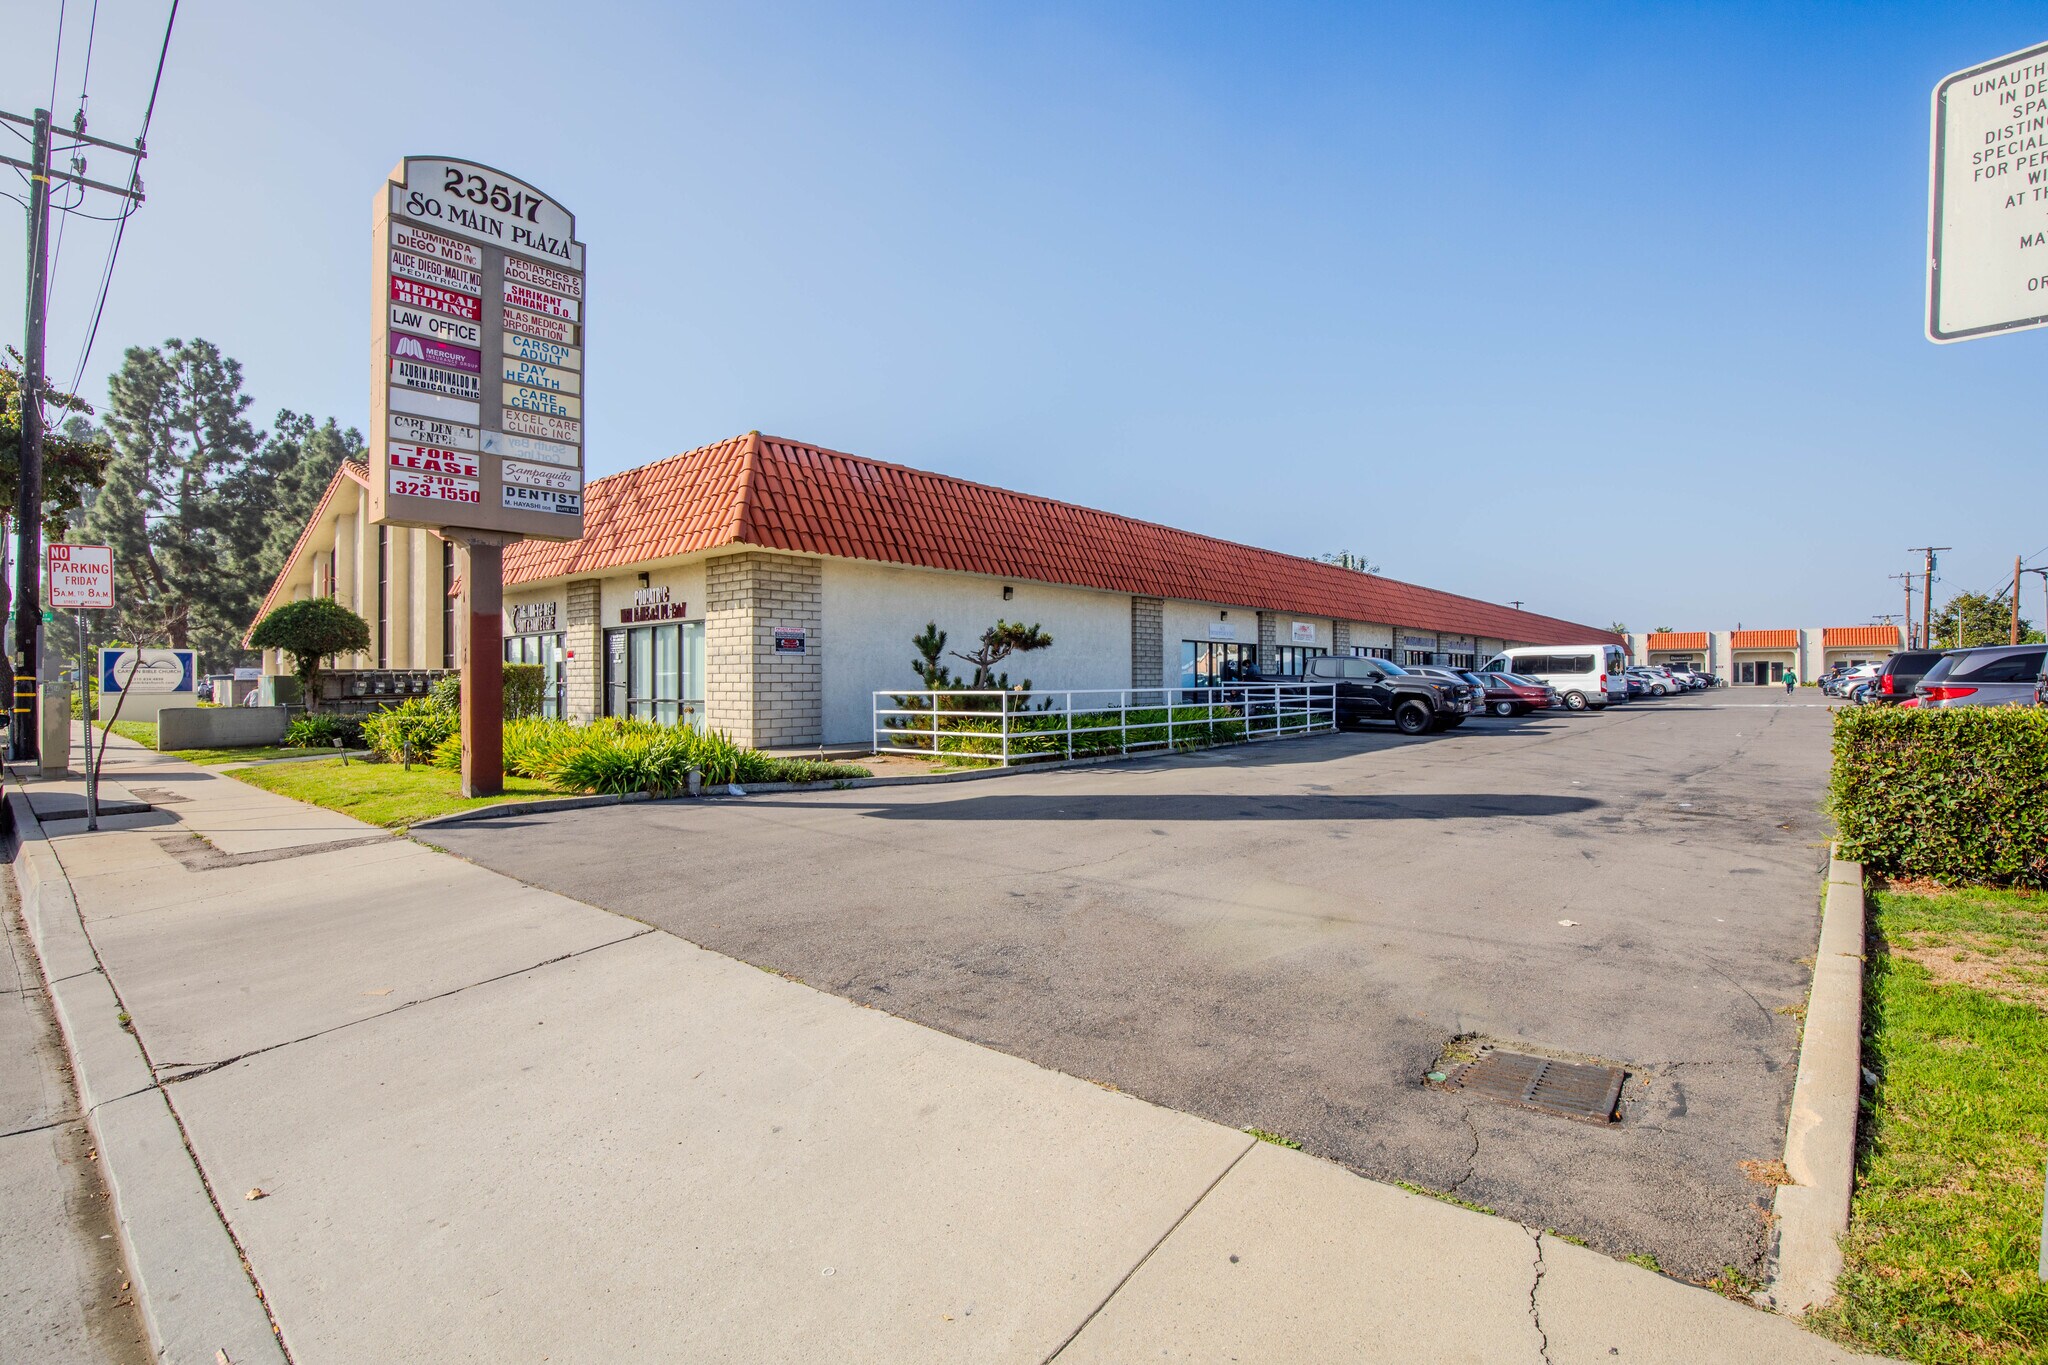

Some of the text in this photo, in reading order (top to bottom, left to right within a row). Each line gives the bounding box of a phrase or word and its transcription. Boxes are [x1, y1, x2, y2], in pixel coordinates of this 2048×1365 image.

[2000, 79, 2048, 106] IN DE
[2013, 98, 2048, 118] SPA
[1986, 116, 2048, 144] DISTIN
[1973, 134, 2048, 164] SPECIAL
[1974, 162, 2008, 182] FOR
[444, 166, 544, 224] 23517
[2005, 192, 2026, 208] AT
[406, 192, 572, 260] SO. MAIN PLAZA
[398, 233, 436, 253] DIEGO
[412, 229, 472, 253] ILUMINADA
[2020, 230, 2048, 249] MA
[392, 252, 415, 268] ALICE
[400, 266, 477, 292] PEDIATRICIAN
[506, 267, 580, 296] ADOLESCENTS
[510, 258, 579, 286] PEDIATRICS &
[394, 280, 476, 309] MEDICAL
[398, 290, 472, 318] BILLING
[512, 286, 562, 306] SHRIKANT
[554, 306, 572, 318] D.O.
[393, 310, 476, 341] LAW OFFICE
[531, 316, 568, 333] MEDICAL
[426, 348, 466, 362] MERCURY
[512, 336, 568, 358] CARSON
[520, 348, 562, 365] ADULT
[400, 362, 426, 380] AZURIN
[430, 368, 470, 389] AGUINALDO
[521, 363, 546, 376] DAY
[406, 378, 480, 398] MEDICAL CLINIC
[506, 370, 560, 390] HEALTH
[520, 388, 556, 404] CARE
[512, 397, 566, 416] CENTER
[394, 416, 474, 438] CARE DENAL
[506, 410, 578, 432] EXCEL CARE
[508, 422, 574, 441] CLINIC INC.
[416, 446, 454, 461] FOR
[391, 454, 478, 476] LEASE
[423, 475, 454, 486] 310
[514, 475, 565, 488] VIDEO
[396, 480, 480, 503] 323-1550
[506, 487, 578, 504] DENTIST
[52, 546, 68, 559] NO
[54, 562, 108, 574] PARKING
[66, 576, 98, 585] FRIDAY
